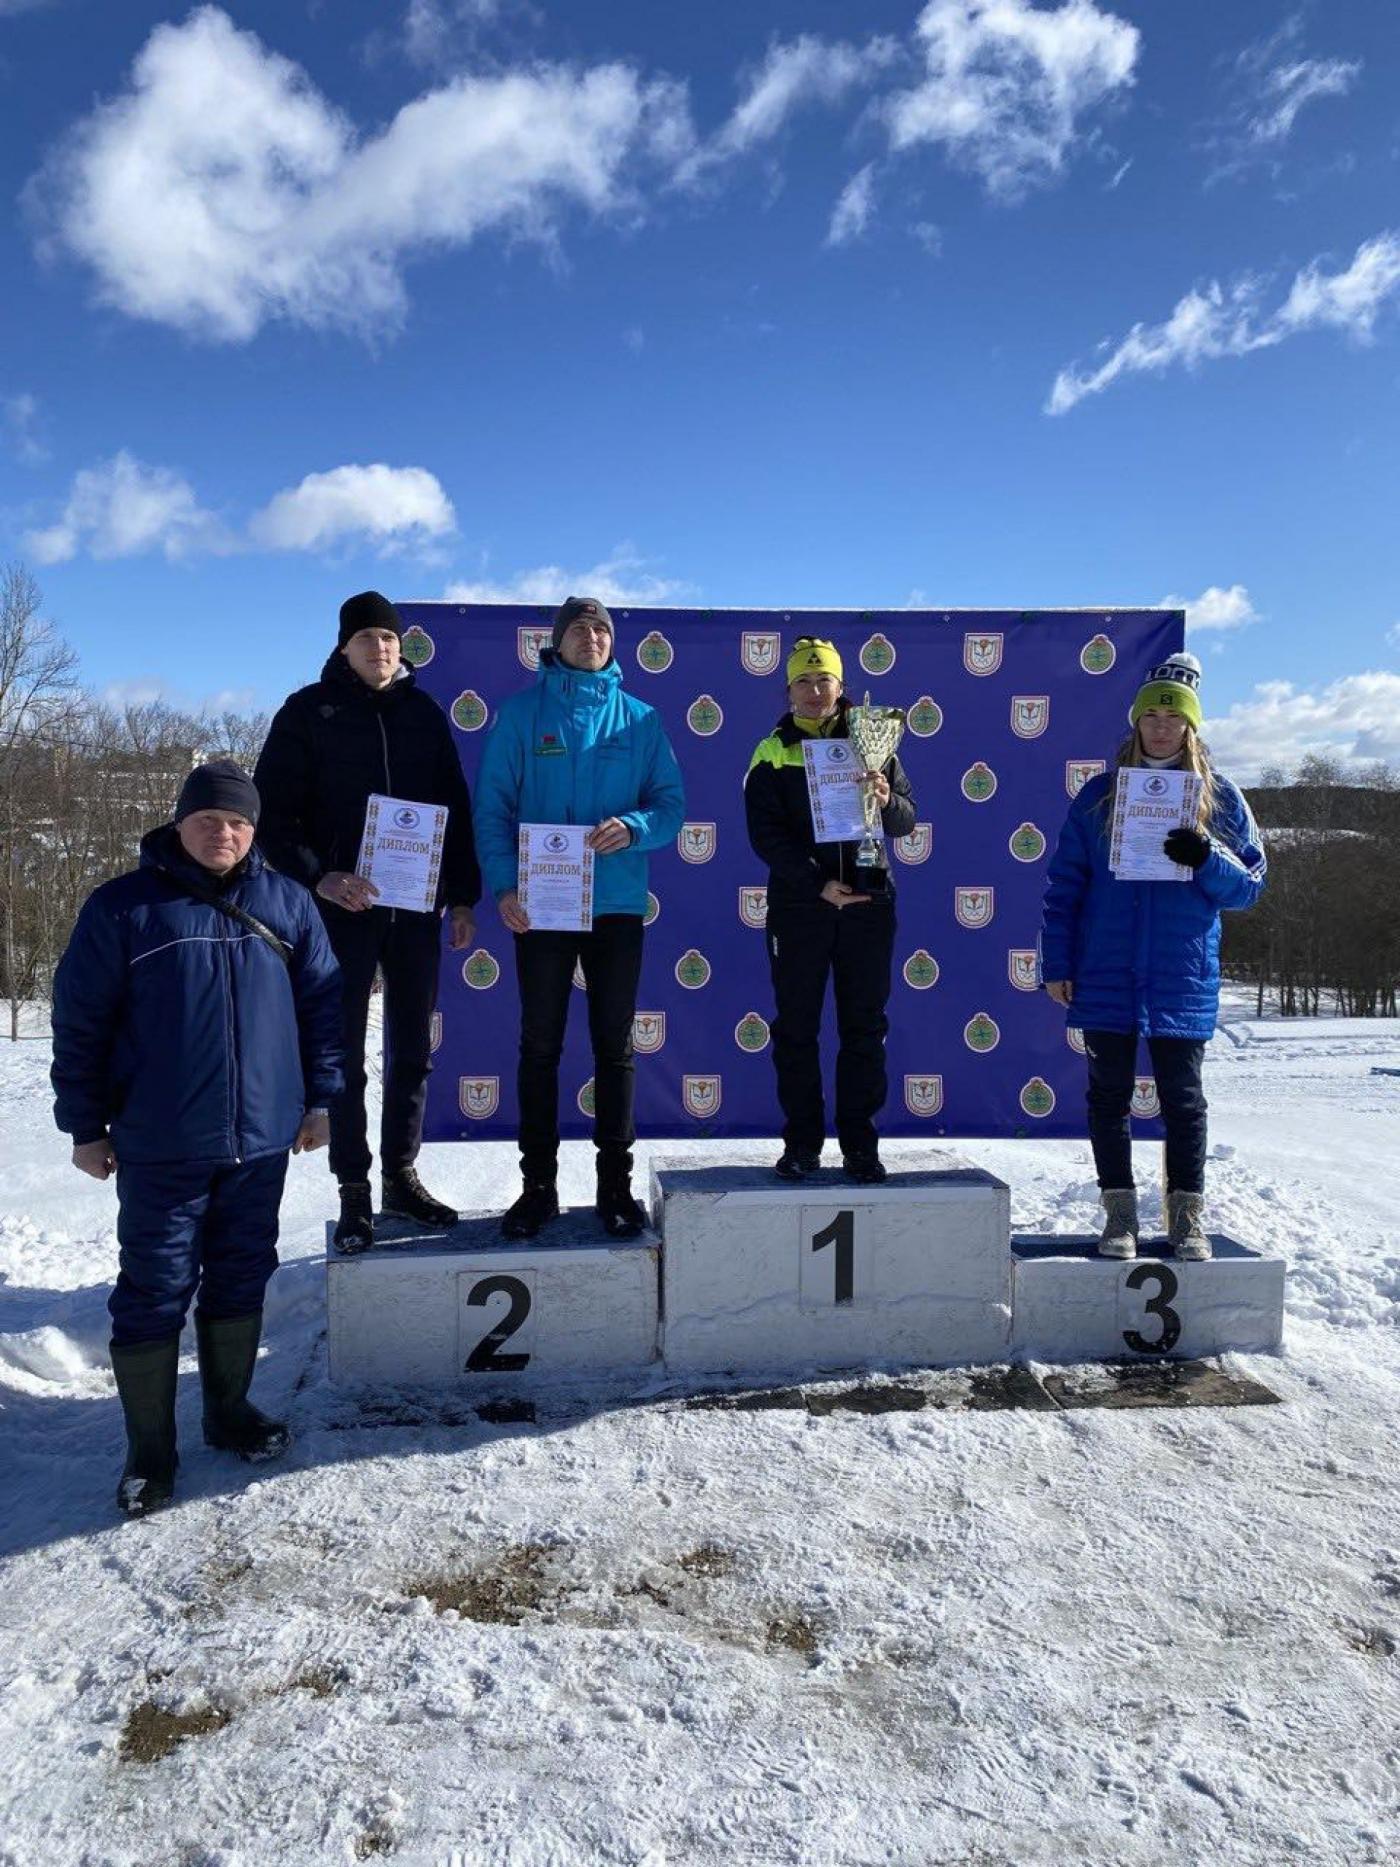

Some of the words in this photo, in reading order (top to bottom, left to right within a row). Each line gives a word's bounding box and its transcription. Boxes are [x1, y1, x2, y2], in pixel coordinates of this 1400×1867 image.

[820, 771, 861, 786] ДИПЛО
[1128, 805, 1179, 819] ДИПЛОМ
[377, 837, 430, 855] ДИПЛОМ
[531, 863, 581, 877] ДИПЛОМ
[812, 1210, 854, 1305] 1
[1122, 1264, 1180, 1352] 3
[465, 1275, 531, 1372] 2
